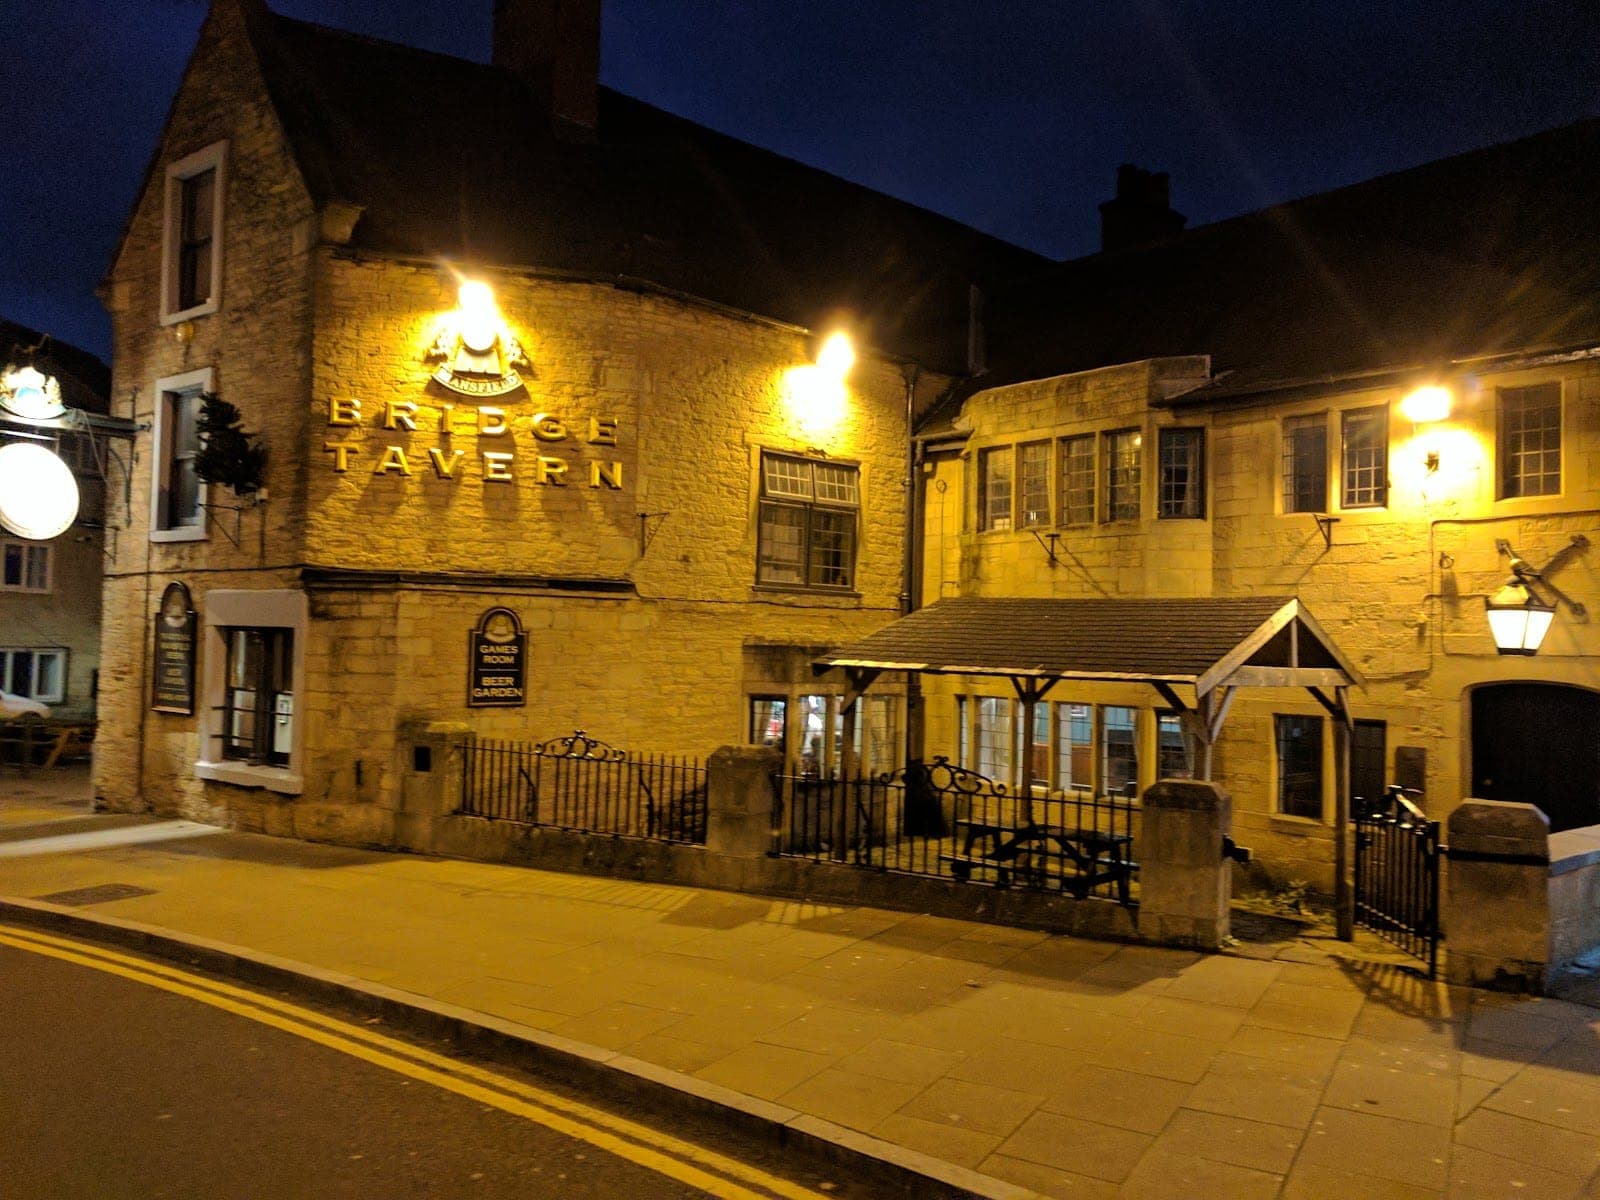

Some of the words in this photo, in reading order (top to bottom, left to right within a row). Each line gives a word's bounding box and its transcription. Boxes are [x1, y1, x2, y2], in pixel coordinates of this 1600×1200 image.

[329, 397, 617, 448] BRIDGE
[323, 441, 623, 490] TAVERN
[480, 645, 519, 654] GAMES
[483, 655, 515, 665] ROOM
[482, 676, 515, 687] BEER
[474, 687, 523, 697] GARDEN
